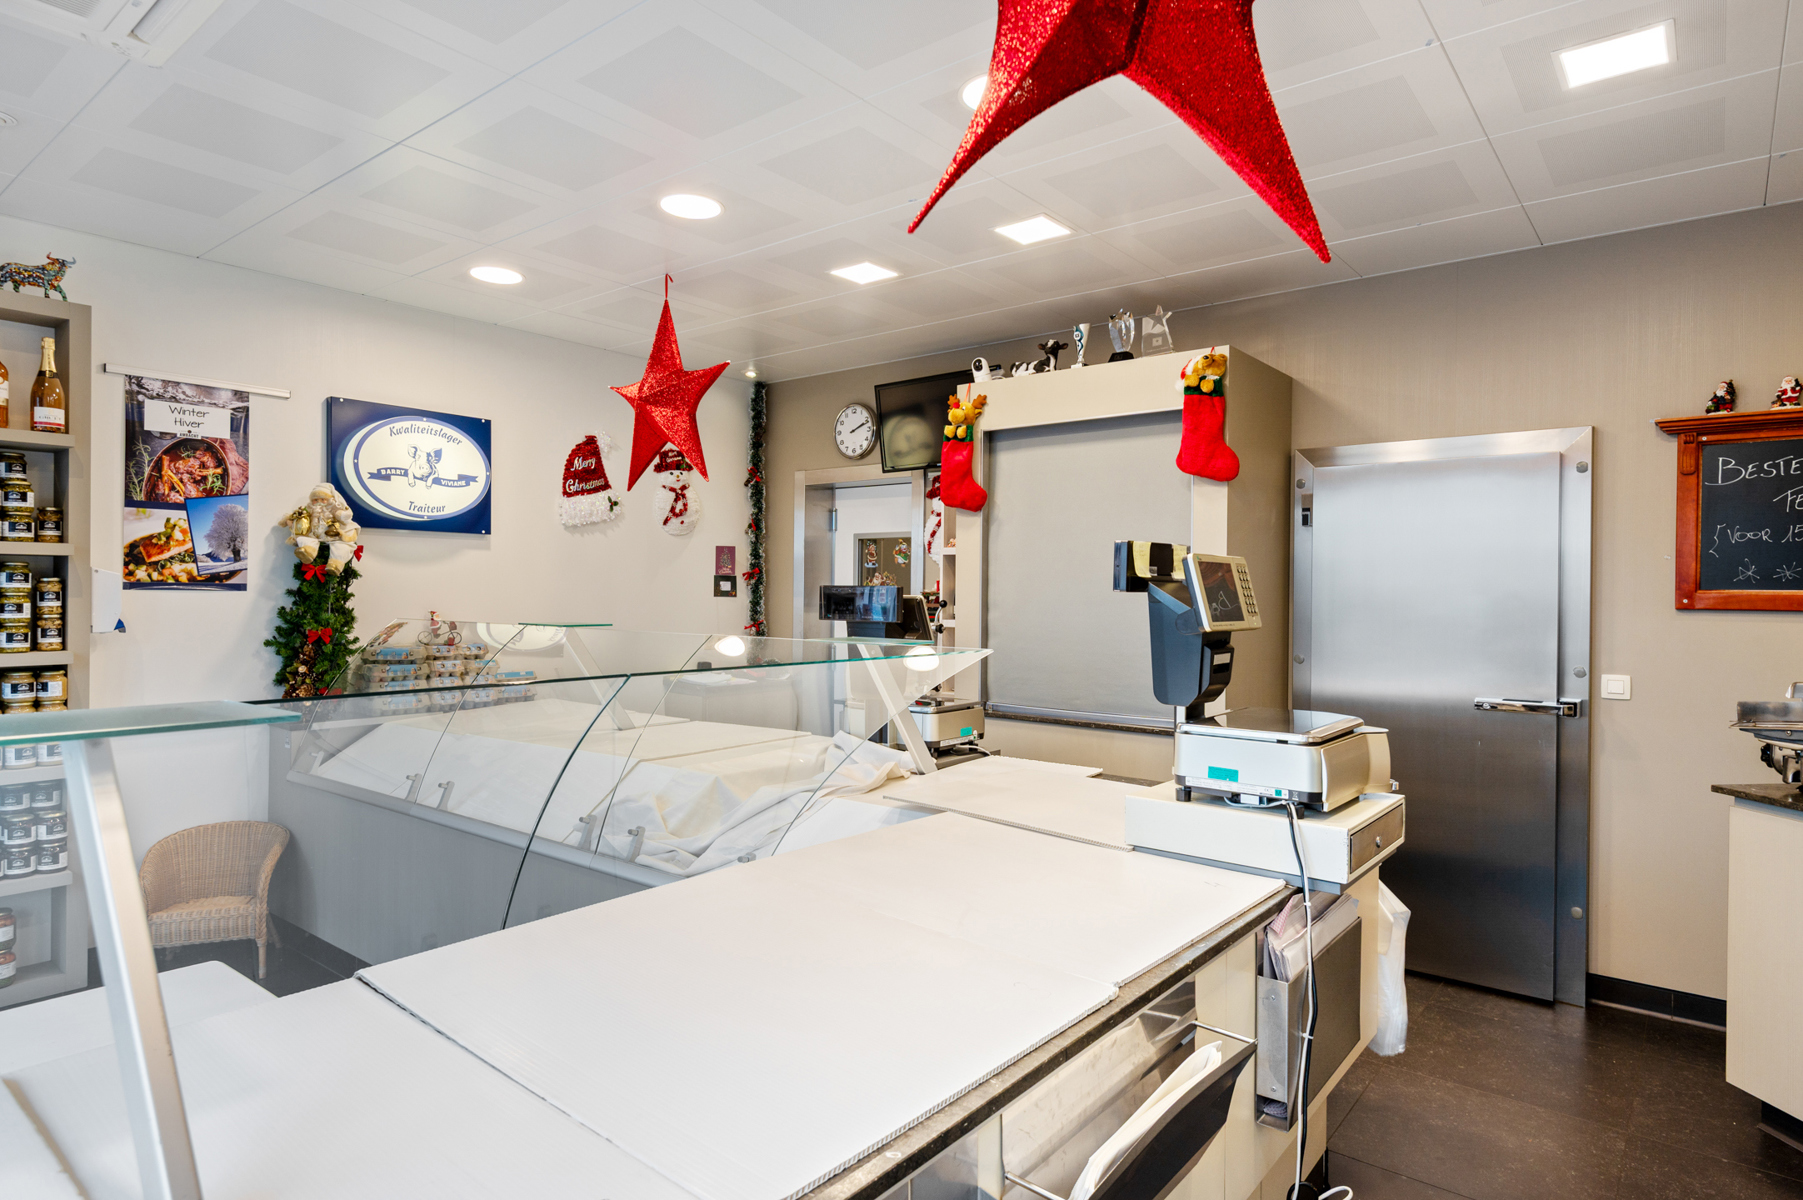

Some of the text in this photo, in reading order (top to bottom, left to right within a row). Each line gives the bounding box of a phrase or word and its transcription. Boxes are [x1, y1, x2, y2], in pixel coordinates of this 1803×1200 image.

[168, 405, 210, 418] Winter
[174, 417, 204, 428] Hiver
[389, 424, 462, 445] Kwaliteitslager
[570, 456, 596, 471] Merry
[565, 478, 605, 493] Christmas
[408, 501, 446, 513] Traiteur
